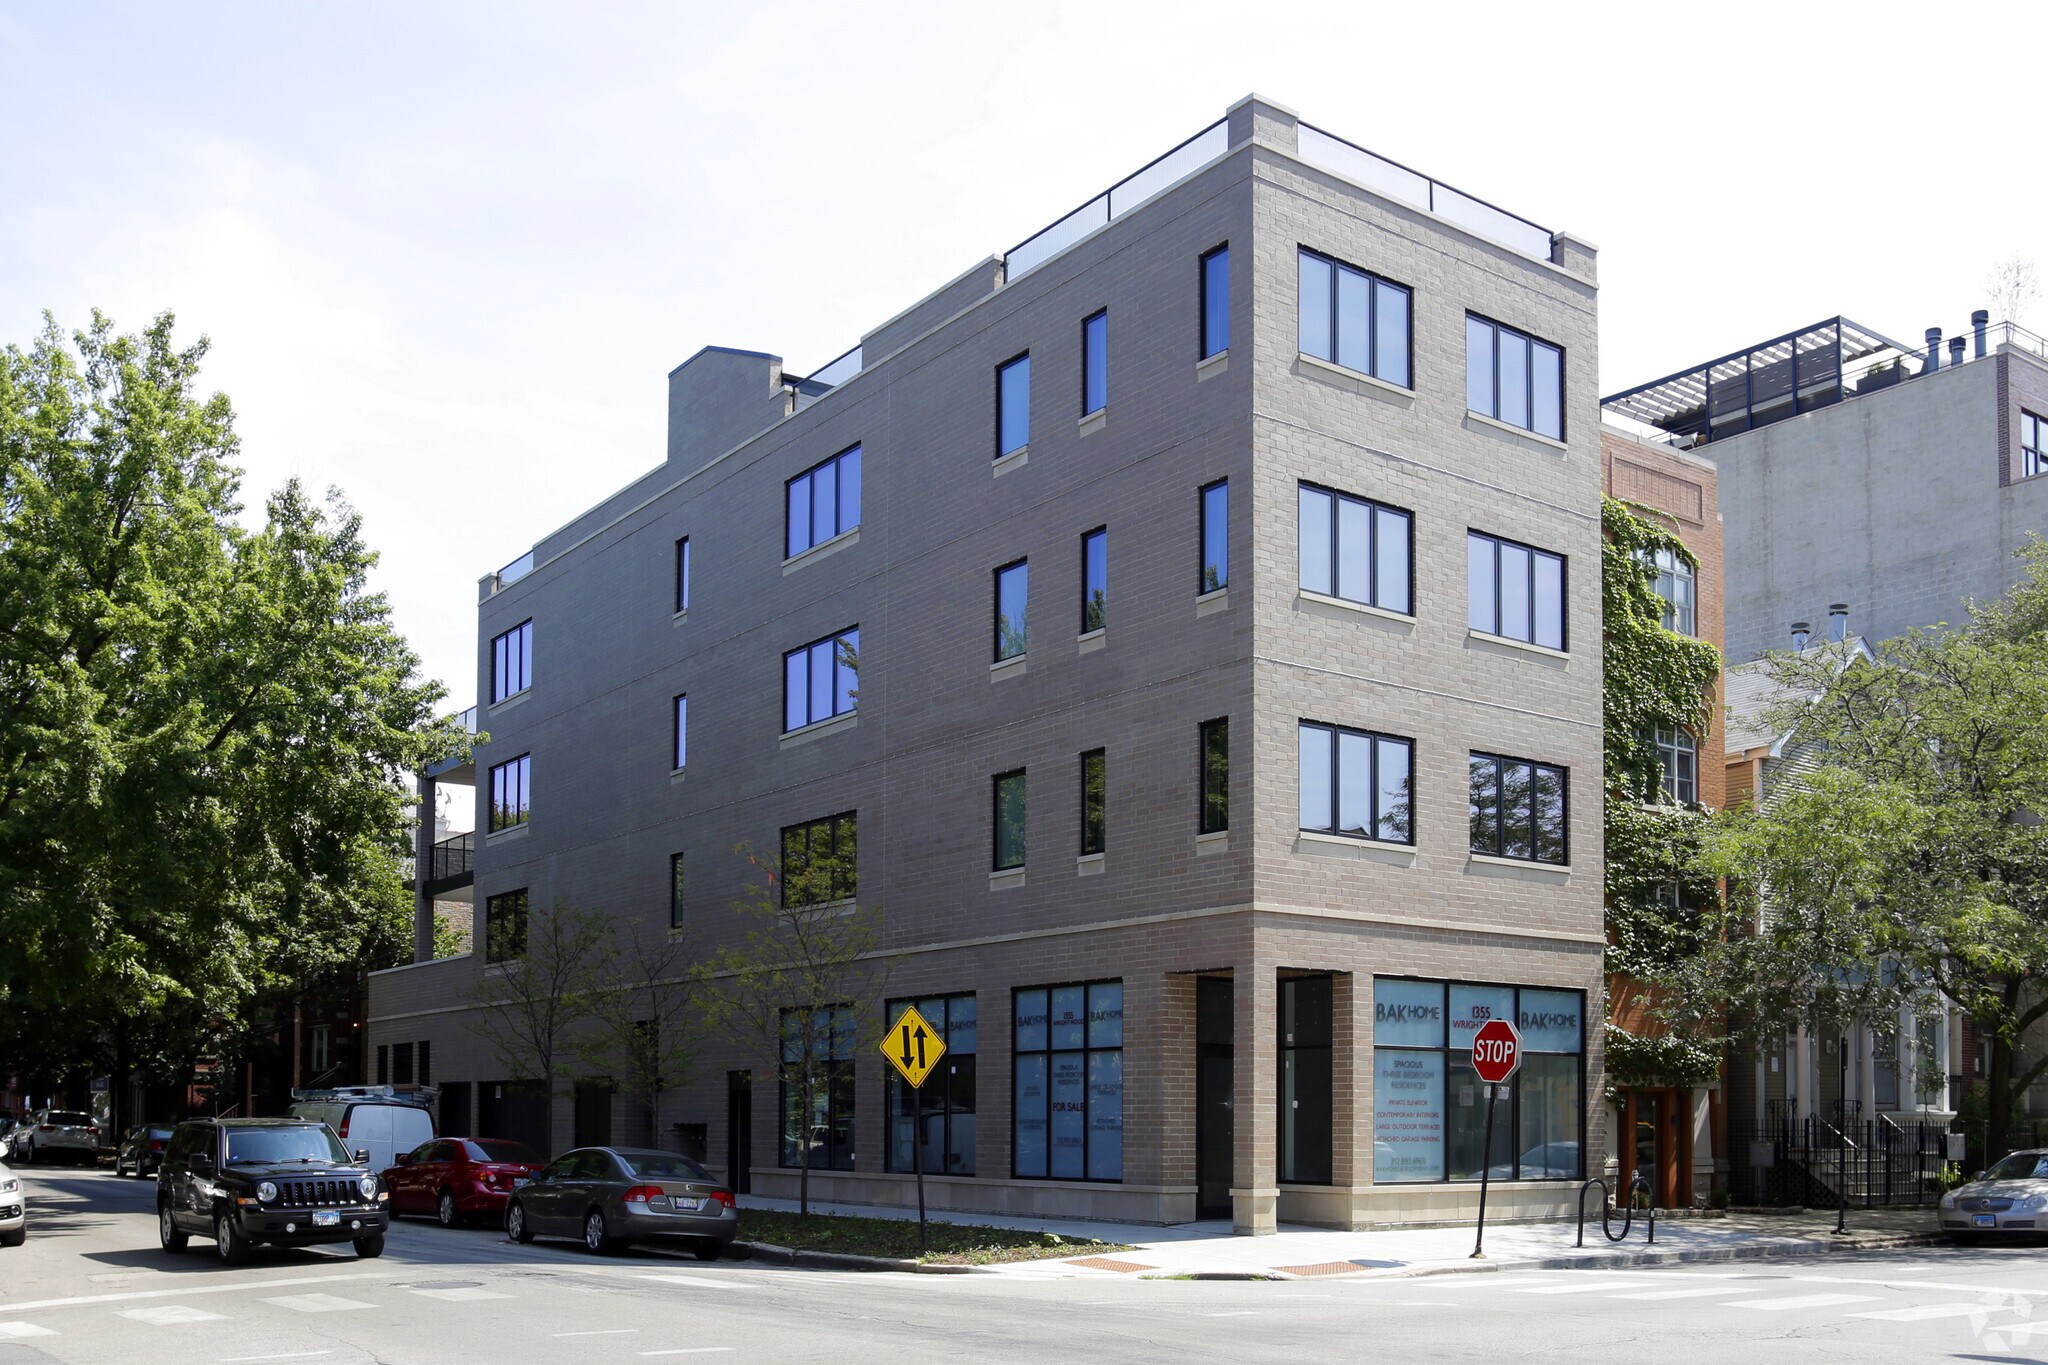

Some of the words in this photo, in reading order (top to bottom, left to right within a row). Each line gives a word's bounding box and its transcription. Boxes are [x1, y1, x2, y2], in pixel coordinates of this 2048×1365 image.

[1376, 1003, 1440, 1023] BAKHOME
[1472, 1006, 1491, 1019] 1355
[1453, 1020, 1484, 1030] WRIGHT
[1521, 1012, 1577, 1031] BAKHOME
[1475, 1039, 1514, 1063] STOP
[1394, 1060, 1424, 1069] SPACIOUS
[1053, 1102, 1066, 1112] FOR
[1067, 1102, 1084, 1112] SALE
